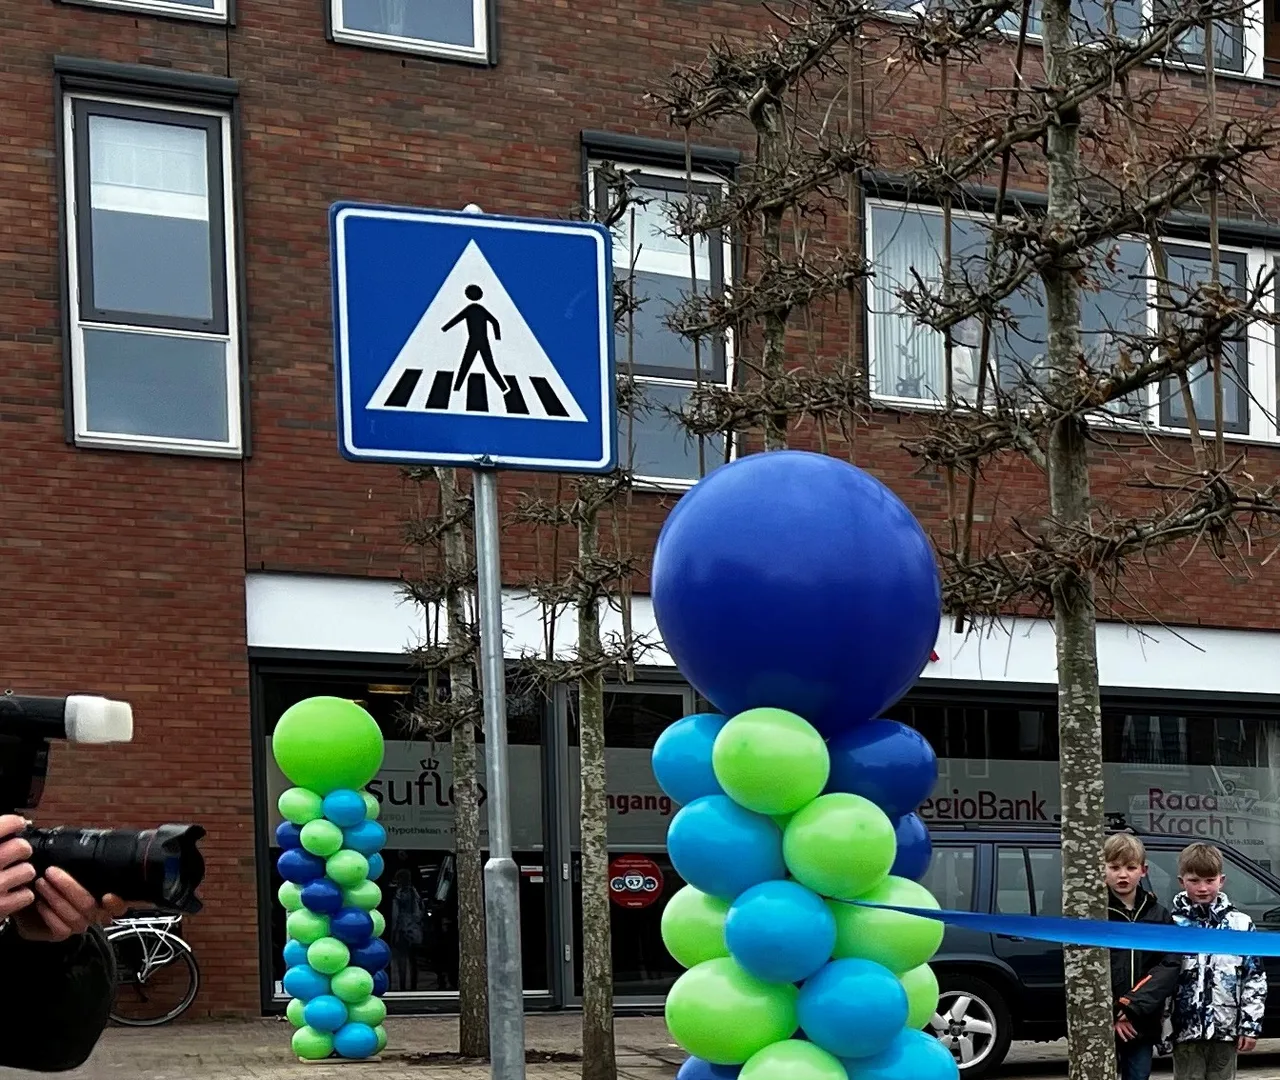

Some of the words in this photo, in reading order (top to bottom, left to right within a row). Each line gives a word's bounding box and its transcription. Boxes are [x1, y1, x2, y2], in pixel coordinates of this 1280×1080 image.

[606, 794, 671, 815] ngang
[919, 788, 1048, 821] egioBank
[388, 826, 442, 835] Hypotheken
[1150, 812, 1236, 836] Kracht
